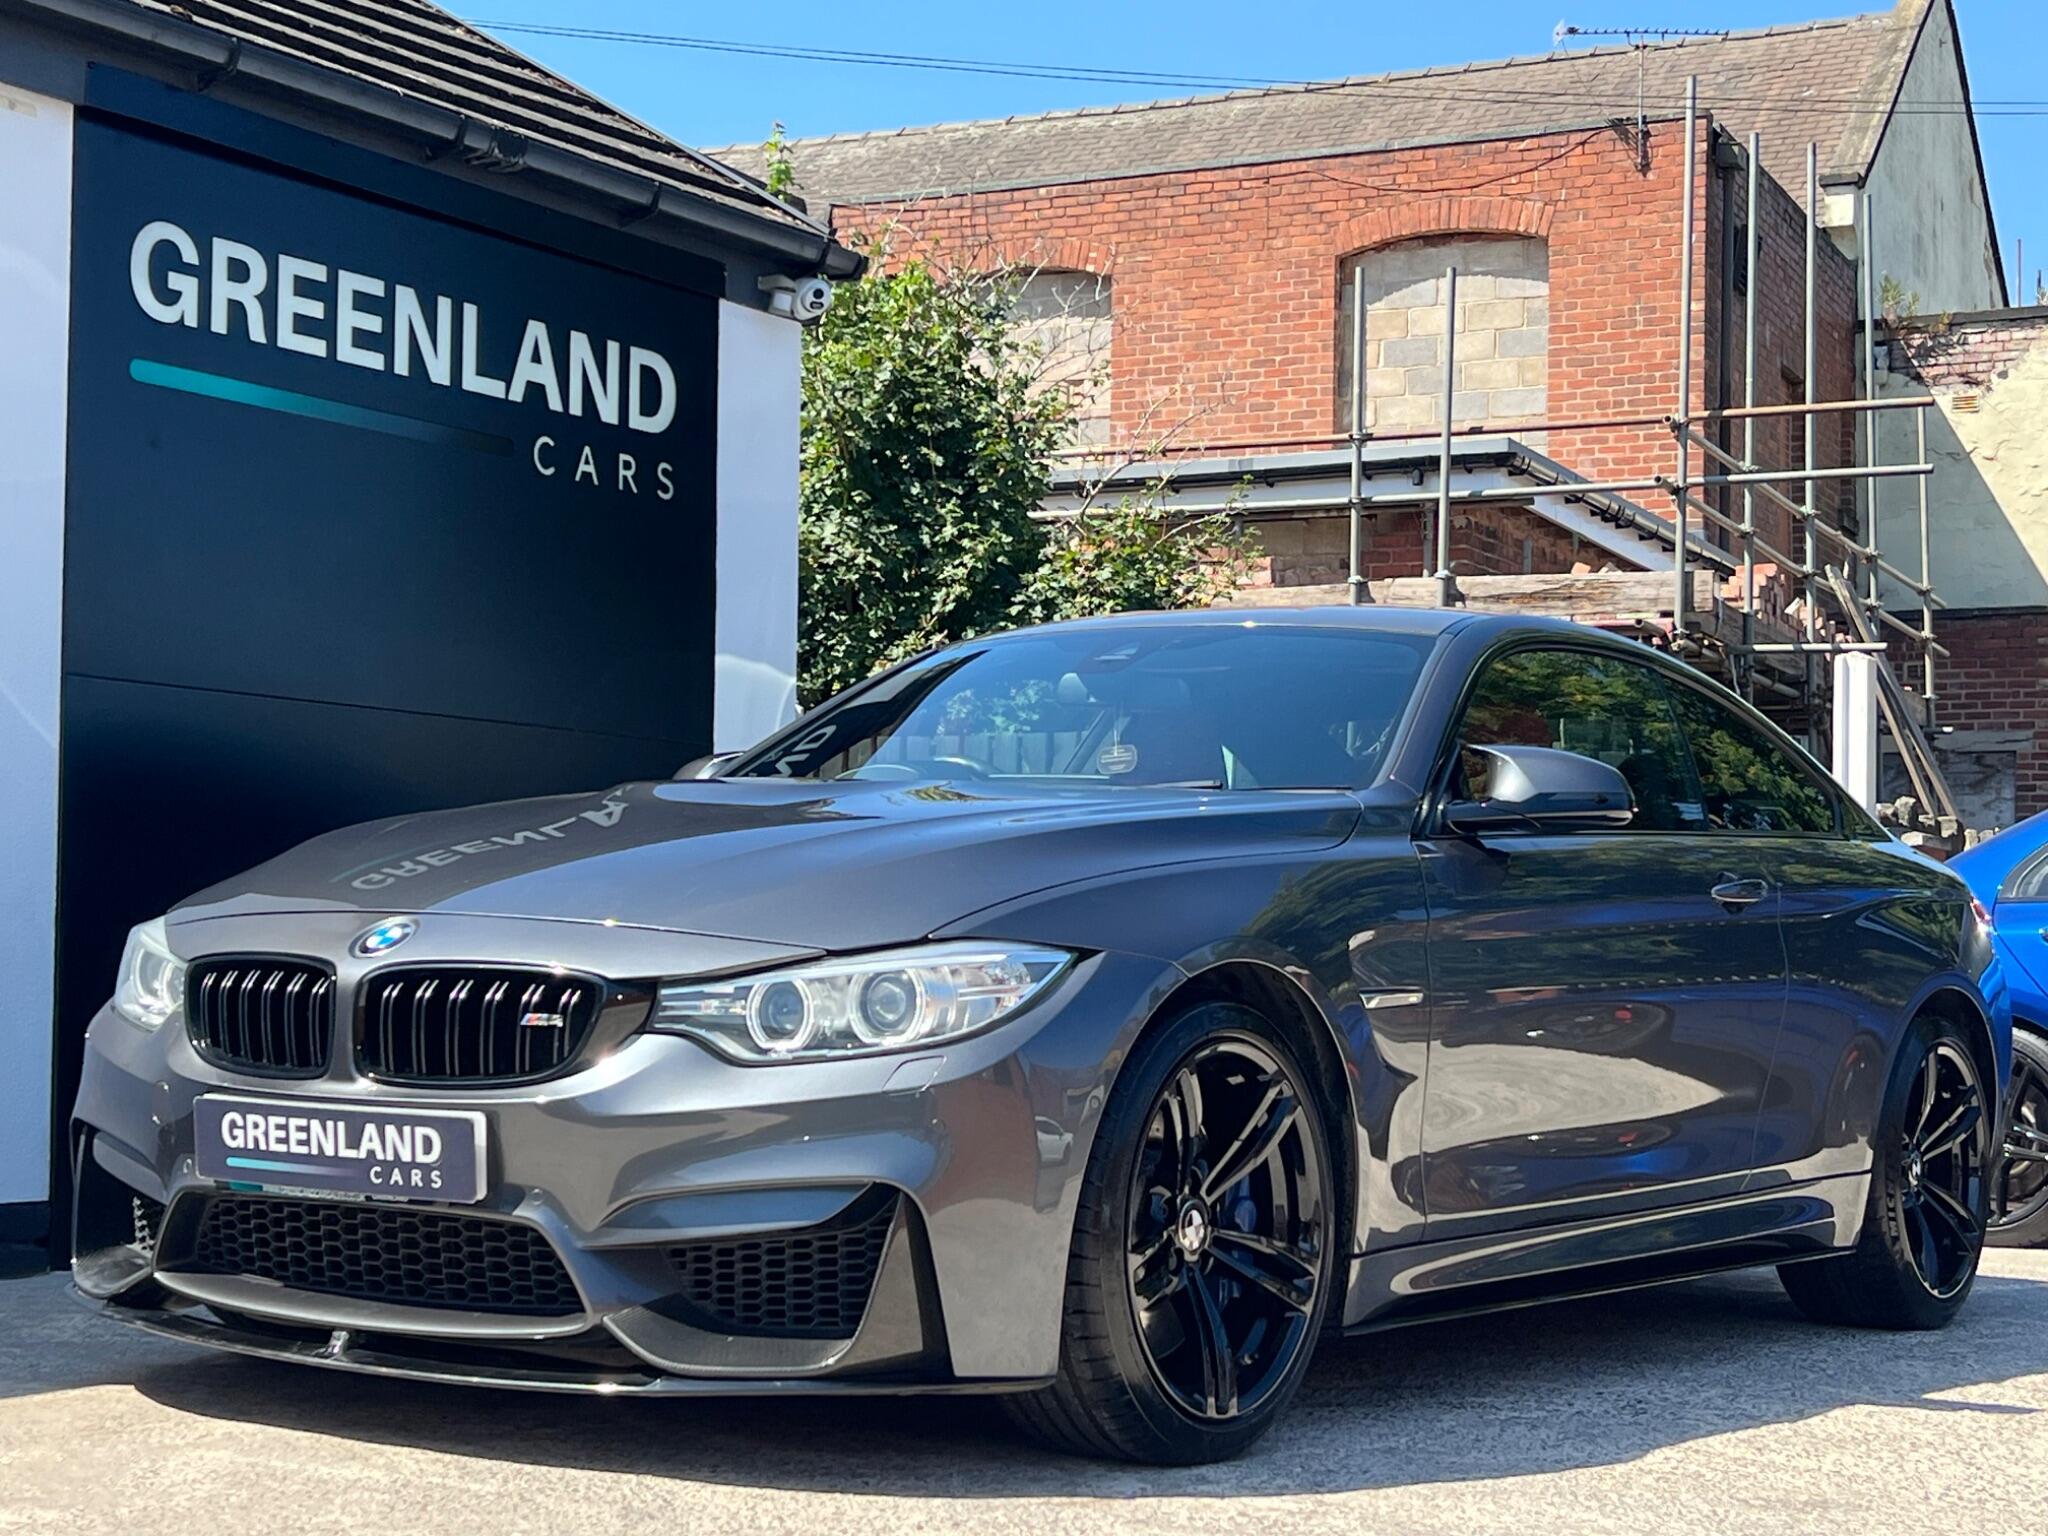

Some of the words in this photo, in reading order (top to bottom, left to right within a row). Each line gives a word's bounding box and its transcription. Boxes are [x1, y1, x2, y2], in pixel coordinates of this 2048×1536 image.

[129, 220, 678, 434] GREENLAND
[533, 436, 675, 500] CARS
[221, 1111, 442, 1164] GREENLAND
[369, 1166, 442, 1189] CARS
